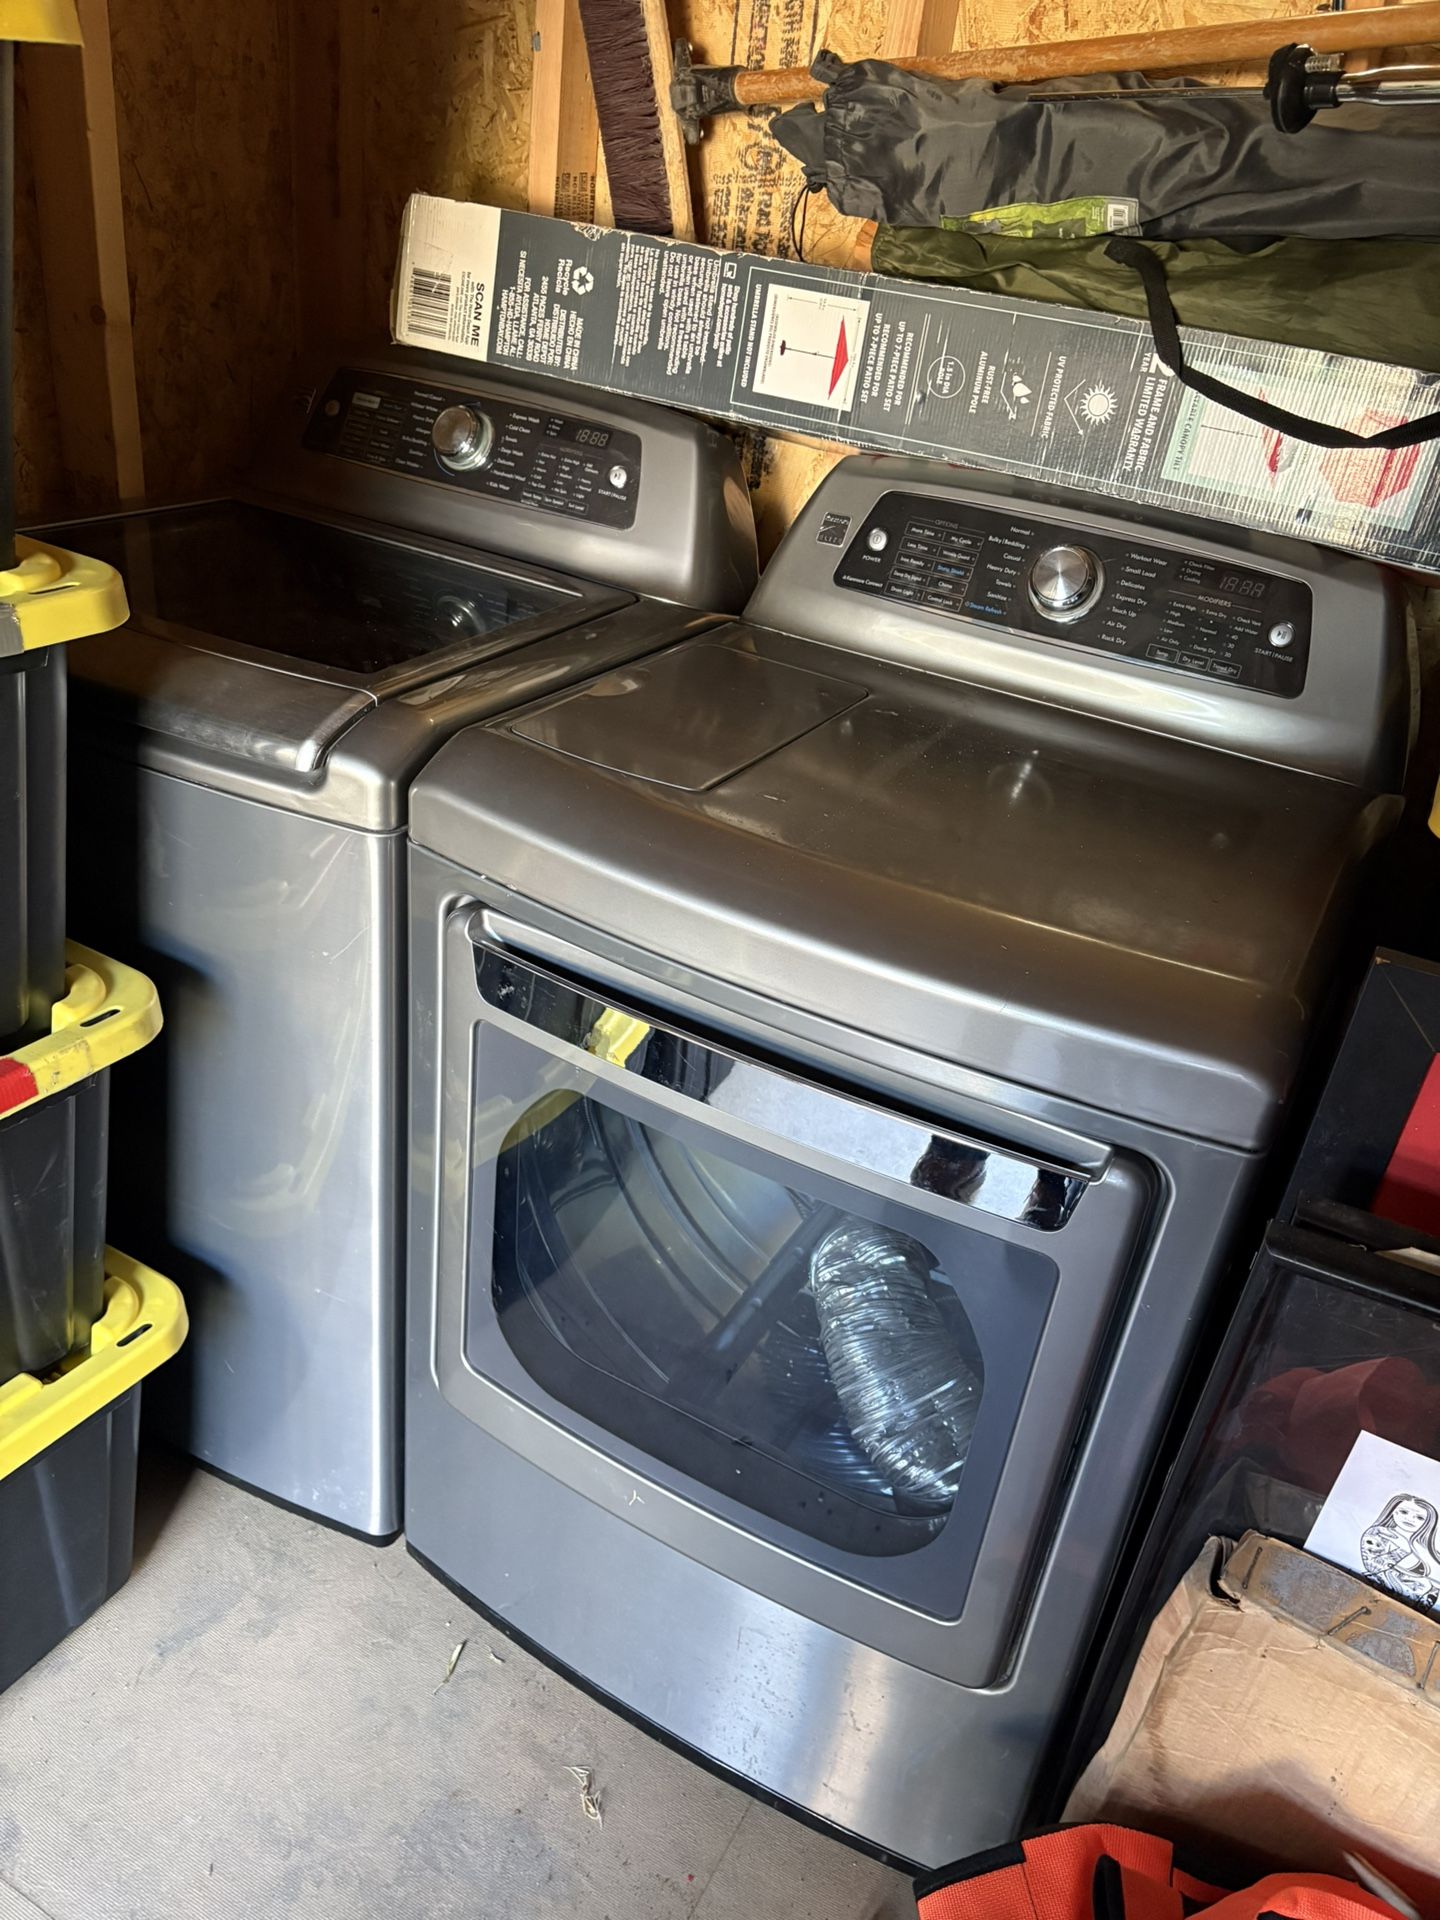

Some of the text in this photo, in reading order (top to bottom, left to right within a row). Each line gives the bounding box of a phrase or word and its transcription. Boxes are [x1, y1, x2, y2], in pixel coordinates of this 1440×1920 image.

[658, 250, 670, 295] unattended.
[669, 251, 675, 263] Do
[678, 253, 688, 286] umbrella
[688, 255, 693, 263] or
[692, 256, 700, 275] base
[554, 258, 565, 293] Recicla
[560, 258, 572, 295] Recycle
[664, 278, 672, 297] leave
[689, 276, 697, 296] when
[709, 259, 719, 293] Umbrella
[470, 282, 484, 346] SCAN ME
[508, 250, 527, 357] SI NECESITA AYUDA, LLAME AL:
[660, 298, 668, 317] open
[667, 288, 677, 310] windy
[675, 287, 683, 307] base.
[686, 297, 694, 316] used
[694, 258, 713, 355] Umbrella should always be
[706, 294, 714, 316] stand
[495, 289, 508, 354] HAMPTONBAY.COM
[515, 276, 531, 358] FOR ASSISTANCE, CALL:
[525, 292, 539, 361] ATLANTA, GA 30339
[532, 275, 548, 362] 2455 PACES FERRY ROAD
[663, 311, 673, 350] conditions.
[684, 317, 692, 333] with
[685, 256, 706, 374] securely fastened to an umbrella
[539, 318, 551, 364] HOME DEPOT
[546, 303, 559, 365] DISTRIBUIDO POR:
[553, 309, 566, 366] DISTRIBUTED BY:
[563, 310, 576, 368] HECHO EN CHINA
[570, 317, 583, 370] MADE IN CHINA
[657, 318, 666, 350] umbrella
[666, 323, 678, 375] recommended
[740, 283, 762, 387] UMBRELLA STAND NOT INCLUDED
[671, 329, 683, 374] freestanding
[859, 312, 882, 403] UP TO 7-PIECE PATIO SET
[870, 323, 890, 397] RECOMMENDED FOR
[882, 320, 905, 411] UP TO 7-PIECE PATIO SET
[1139, 351, 1151, 373] YEAR
[1151, 352, 1177, 377] 2
[893, 332, 914, 406] RECOMMENDED FOR
[941, 360, 954, 394] 1.5 in DIA
[968, 350, 987, 413] ALUMINUM POLE
[981, 365, 995, 404] RUST-FREE
[1041, 355, 1066, 439] UV PROTECTED FABRIC
[1122, 376, 1156, 471] LIMITED WARRANTY
[1134, 378, 1167, 472] FRAME AND FABRIC
[1177, 422, 1191, 454] CANOPY
[1010, 526, 1031, 535] Normal
[862, 555, 881, 563] POWER
[986, 563, 1017, 576] Heavy Duty
[1003, 552, 1021, 561] Casual
[1125, 566, 1156, 578] Small Load
[1130, 553, 1168, 566] Workout Wear
[987, 591, 1007, 601] Sanitize
[995, 578, 1012, 588] Towels
[1116, 593, 1147, 606] Express Dry
[1120, 579, 1145, 590] Delicates
[1112, 606, 1127, 615] Touch
[1198, 595, 1232, 608] MODIFIERS
[1101, 634, 1126, 646] Rack Dry
[1116, 622, 1127, 630] Dry
